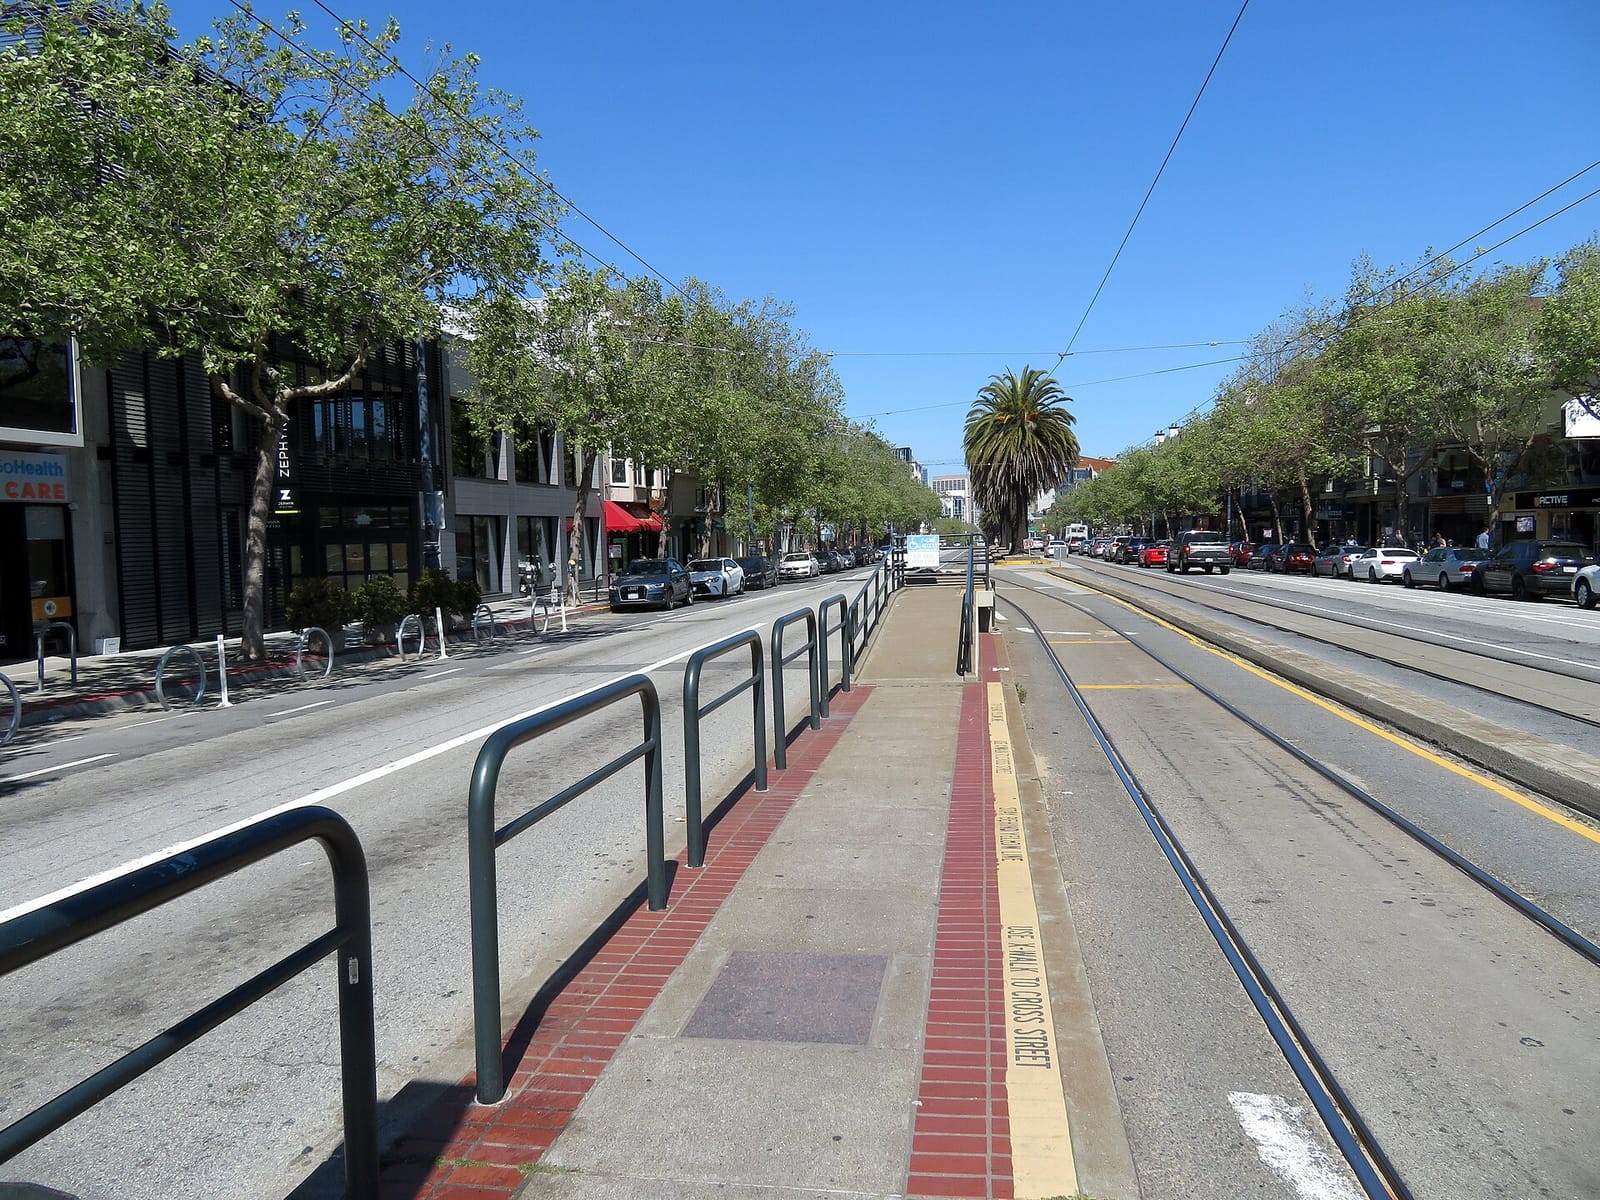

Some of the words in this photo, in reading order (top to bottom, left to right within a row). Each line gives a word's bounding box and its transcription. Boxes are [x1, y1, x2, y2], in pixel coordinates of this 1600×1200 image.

[5, 481, 65, 500] CARE
[1539, 495, 1568, 504] ACTIVE
[1007, 926, 1034, 939] USE
[1010, 977, 1040, 988] TO
[1011, 990, 1045, 1024] CROSS
[1013, 1028, 1051, 1069] STREET
